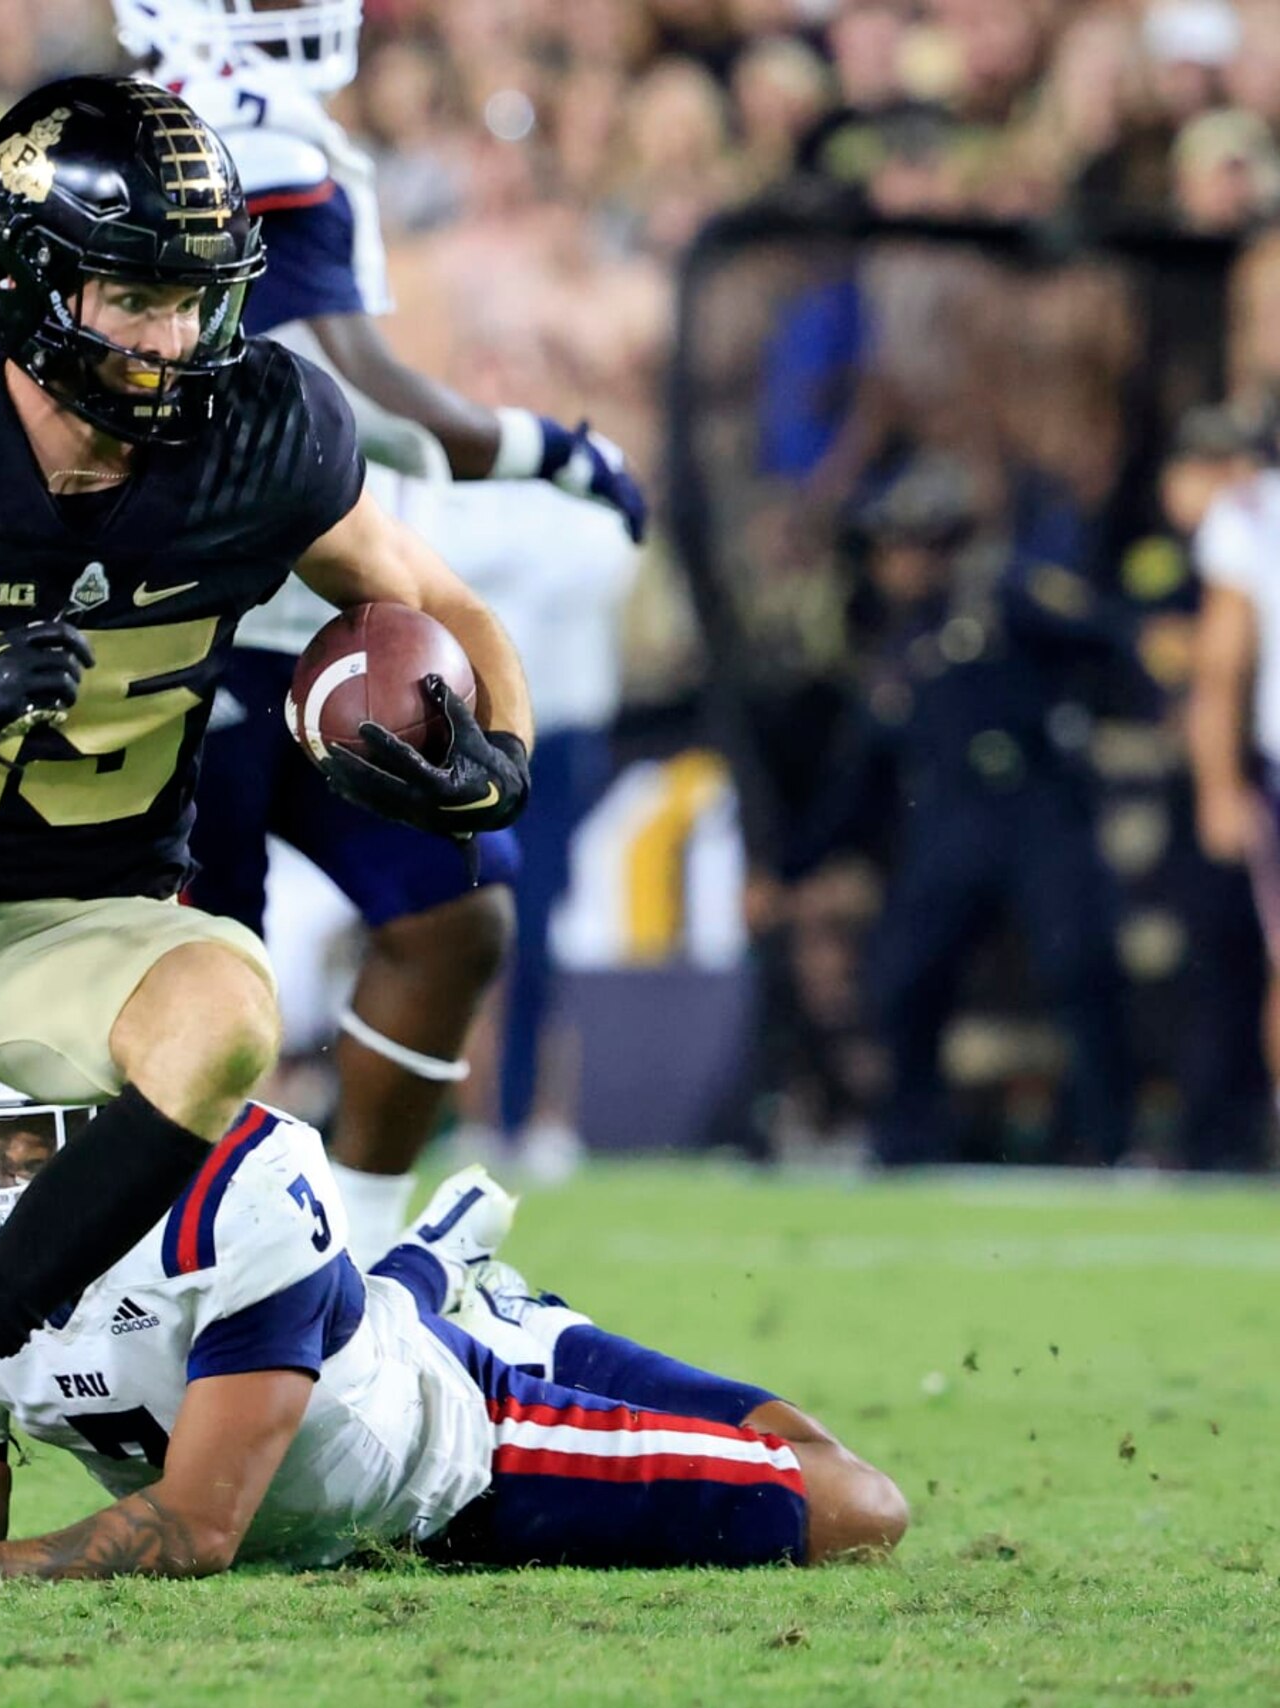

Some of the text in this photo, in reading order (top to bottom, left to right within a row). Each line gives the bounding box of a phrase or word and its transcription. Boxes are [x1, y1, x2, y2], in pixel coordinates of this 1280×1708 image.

[285, 1172, 332, 1253] 3
[111, 1314, 161, 1336] adidas
[53, 1370, 111, 1399] FAU
